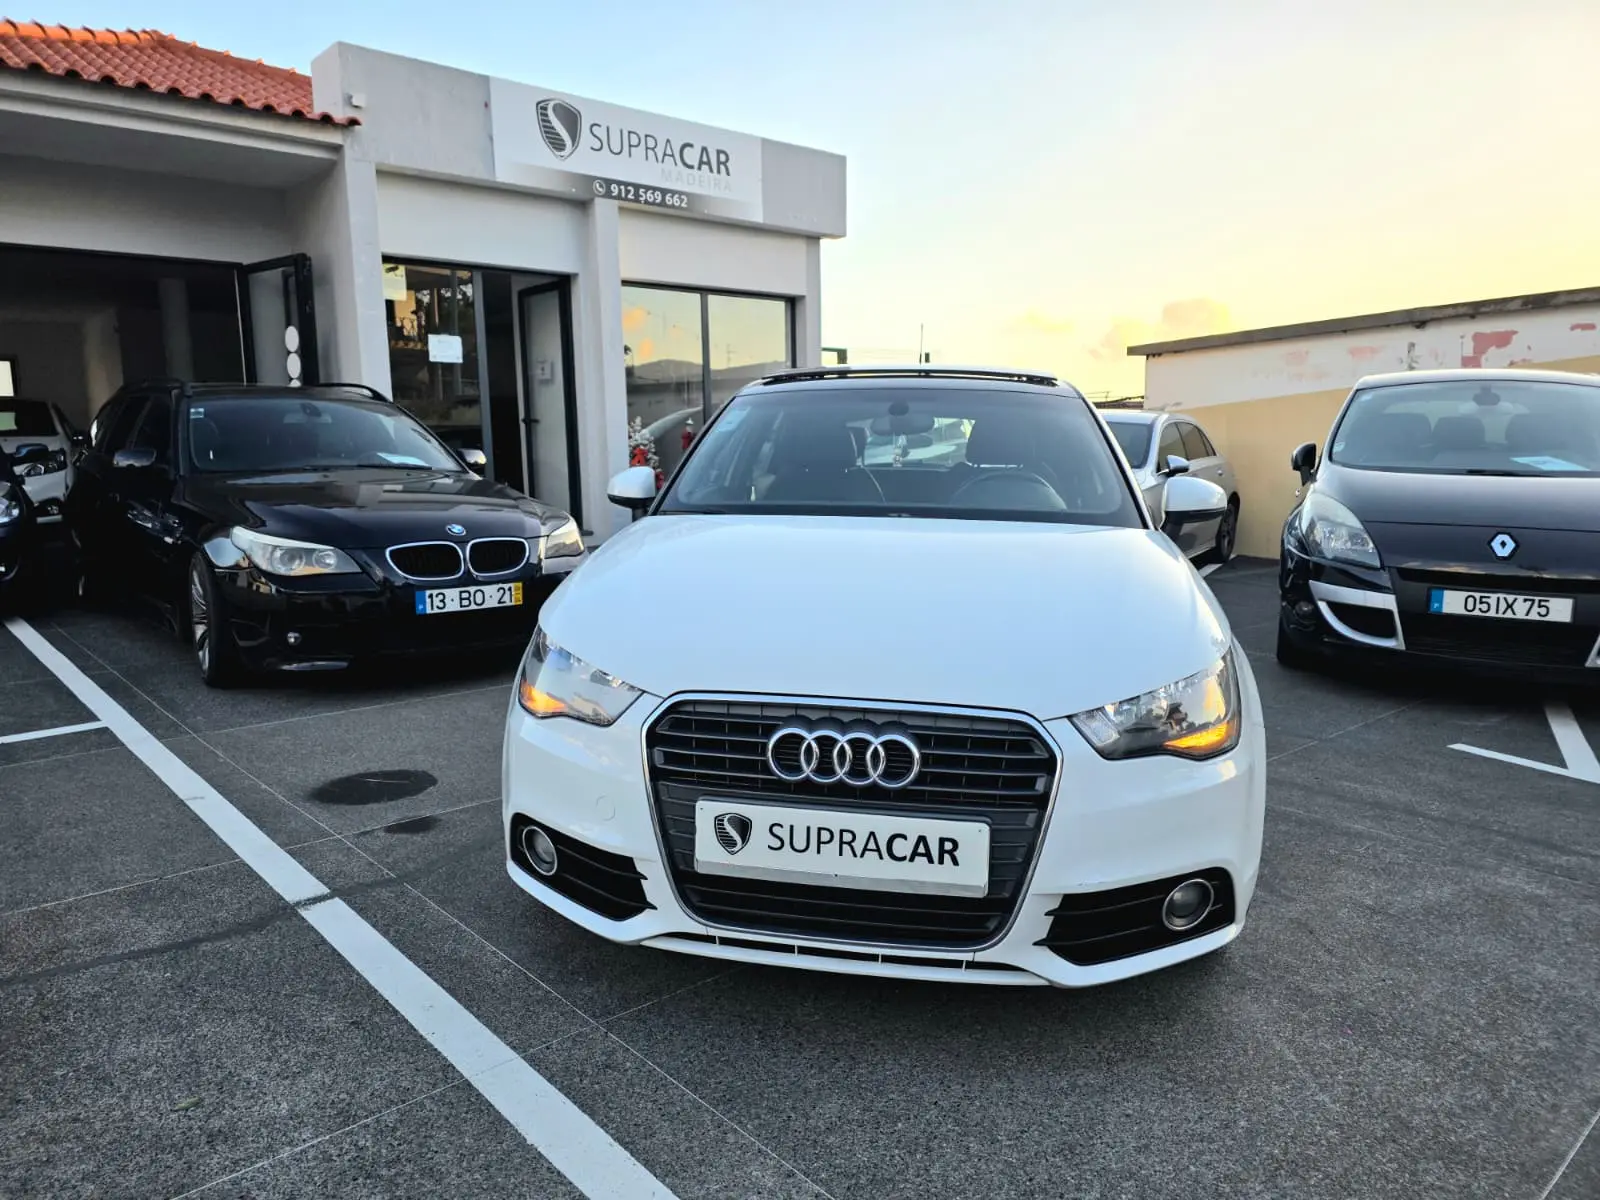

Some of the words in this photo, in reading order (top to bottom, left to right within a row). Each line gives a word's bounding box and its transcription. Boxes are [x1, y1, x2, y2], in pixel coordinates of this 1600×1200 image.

[589, 123, 731, 176] SUPRACAR
[610, 183, 635, 200] 912
[639, 188, 662, 204] 569
[665, 192, 688, 208] 662
[661, 167, 732, 192] MADEIRA
[767, 822, 960, 867] SUPRACAR
